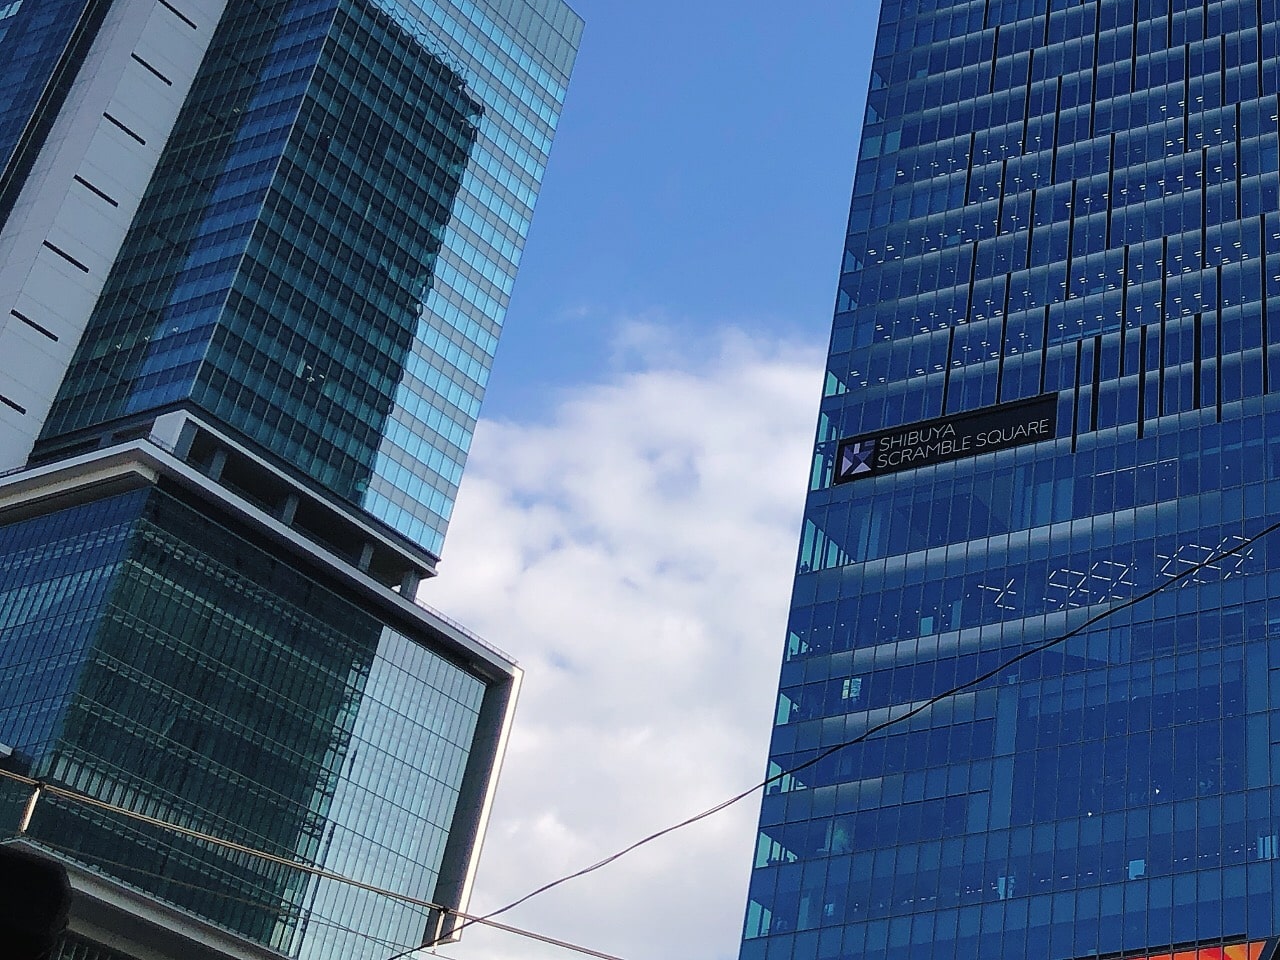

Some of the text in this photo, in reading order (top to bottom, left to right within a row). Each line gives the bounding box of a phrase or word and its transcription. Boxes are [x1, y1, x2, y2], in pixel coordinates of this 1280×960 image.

[876, 418, 1050, 468] SCRAMBLE SQUARE
[879, 423, 956, 452] SHIBUYA
